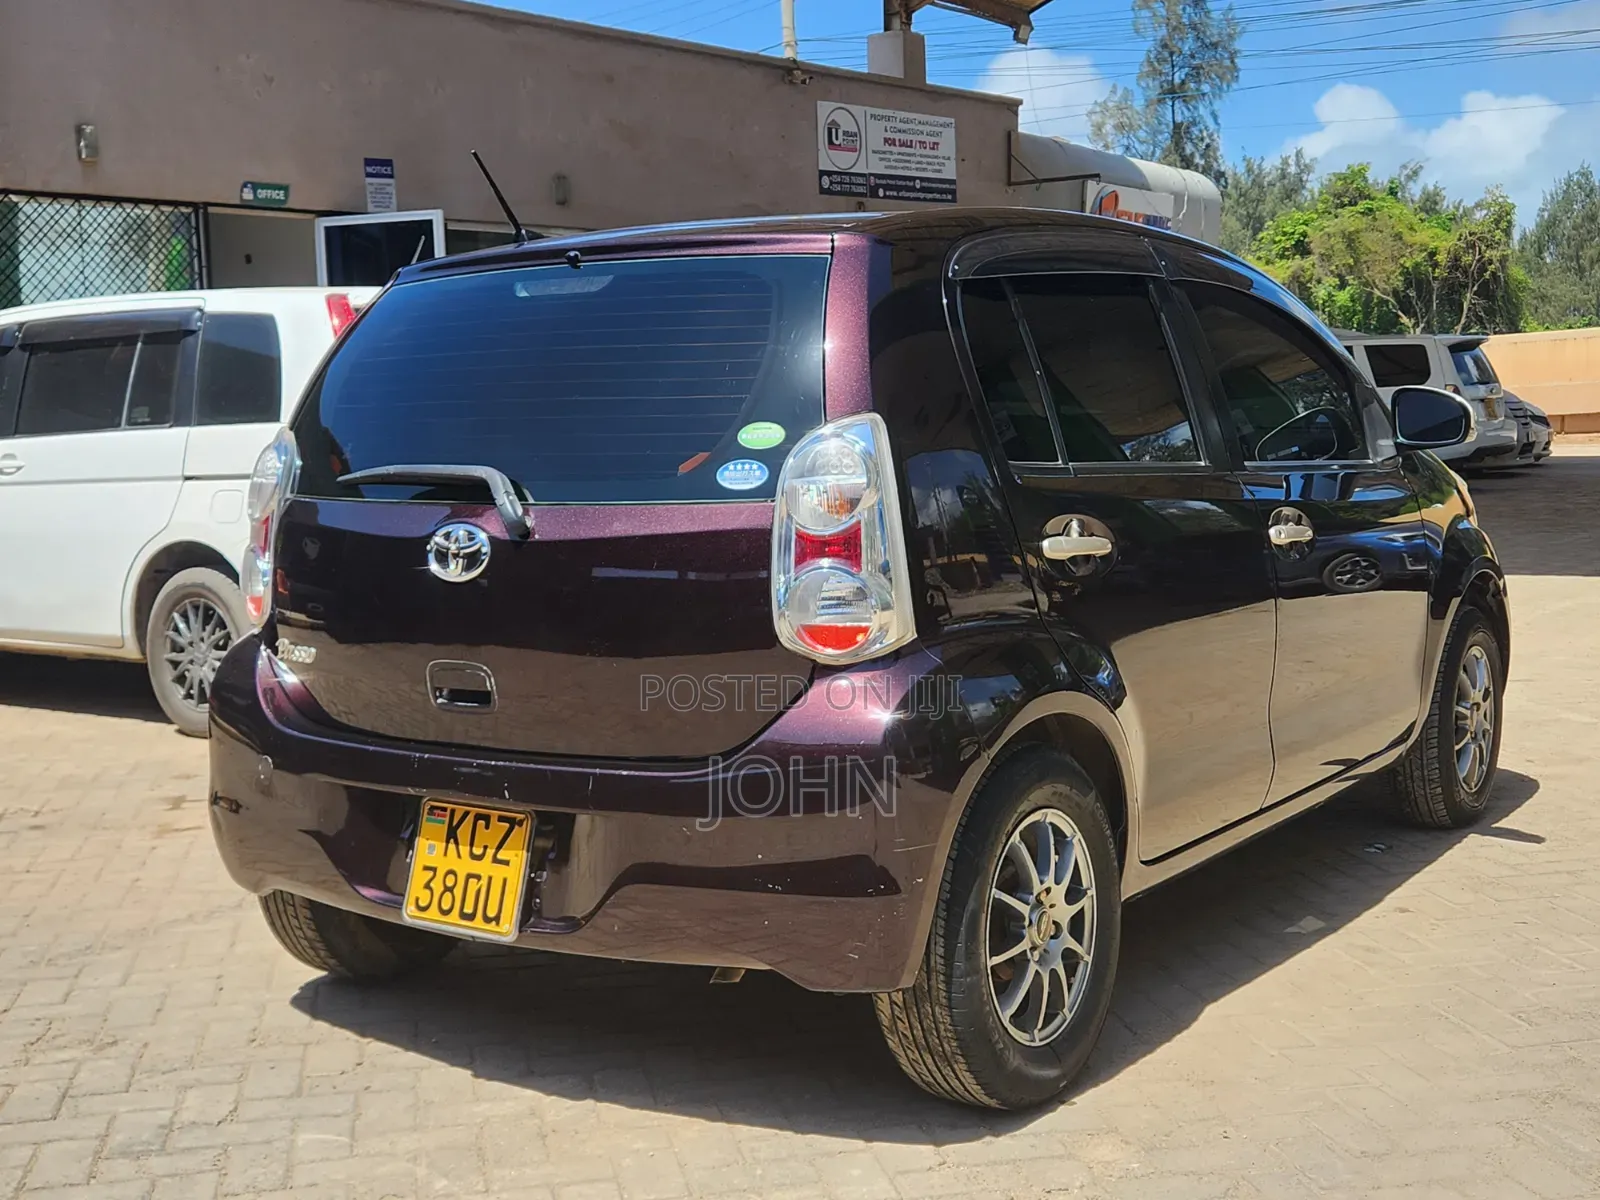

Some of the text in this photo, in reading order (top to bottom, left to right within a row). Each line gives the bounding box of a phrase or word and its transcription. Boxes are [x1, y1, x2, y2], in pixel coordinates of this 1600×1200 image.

[870, 113, 897, 123] PROPERTY
[889, 126, 925, 136] COMMISSION
[883, 137, 897, 147] FOR
[898, 138, 914, 149] SALE
[918, 140, 927, 150] TO
[928, 141, 940, 151] LET
[366, 166, 393, 174] NOTICE
[257, 189, 286, 200] OFFICE
[443, 808, 519, 867] KCZ
[414, 864, 508, 926] 380U
